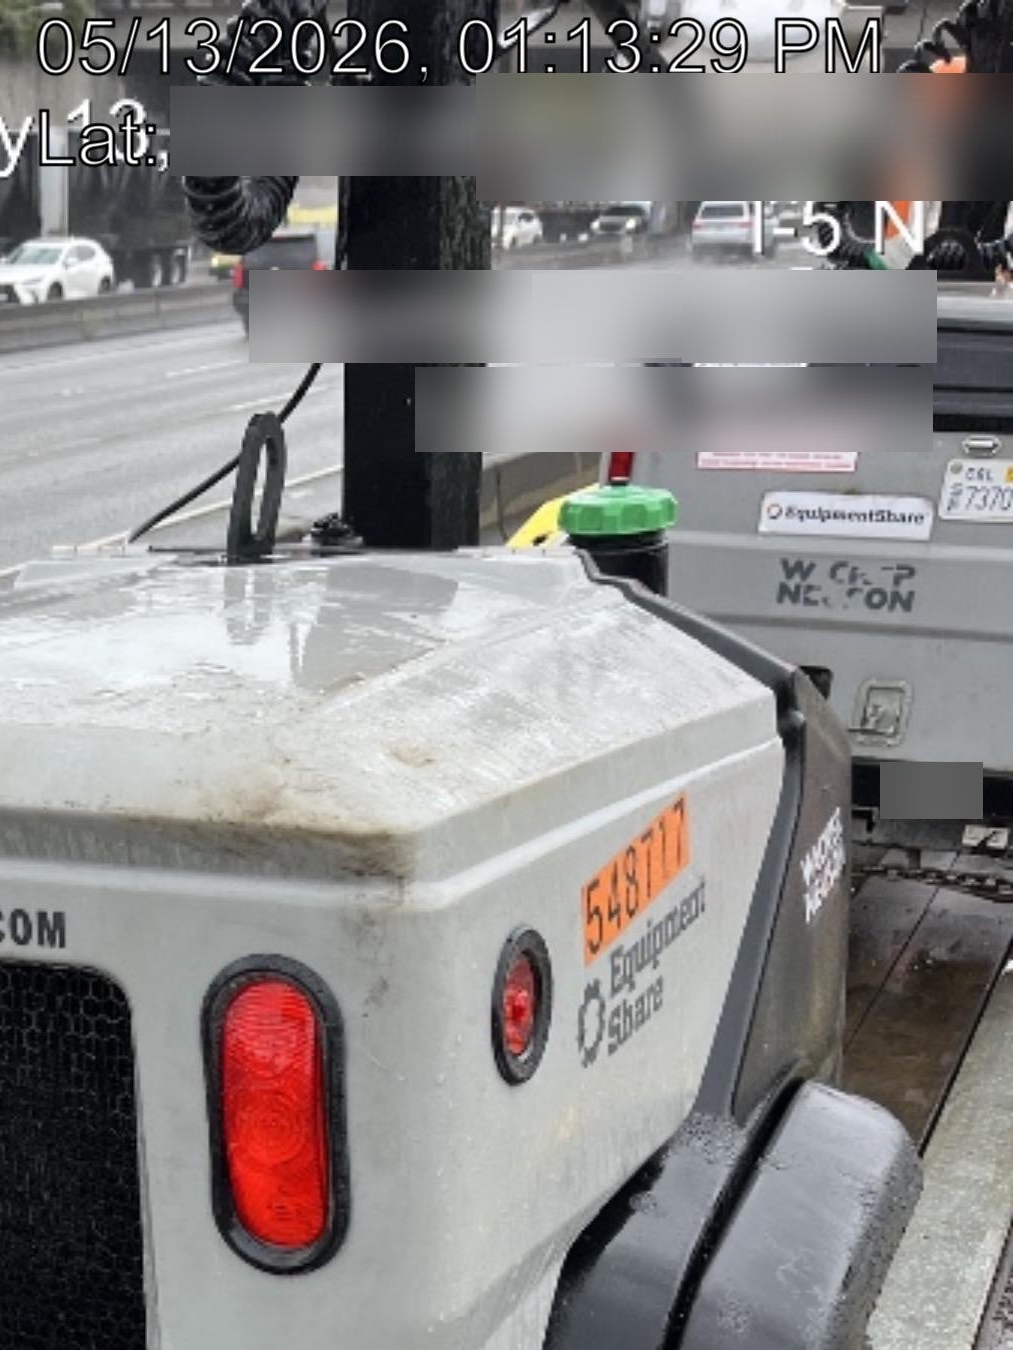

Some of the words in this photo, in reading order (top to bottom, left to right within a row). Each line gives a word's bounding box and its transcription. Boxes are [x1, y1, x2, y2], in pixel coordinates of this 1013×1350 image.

[785, 502, 925, 526] EquipmentShare
[585, 796, 686, 956] 548717
[610, 870, 706, 998] Equipment
[607, 974, 664, 1056] Share
